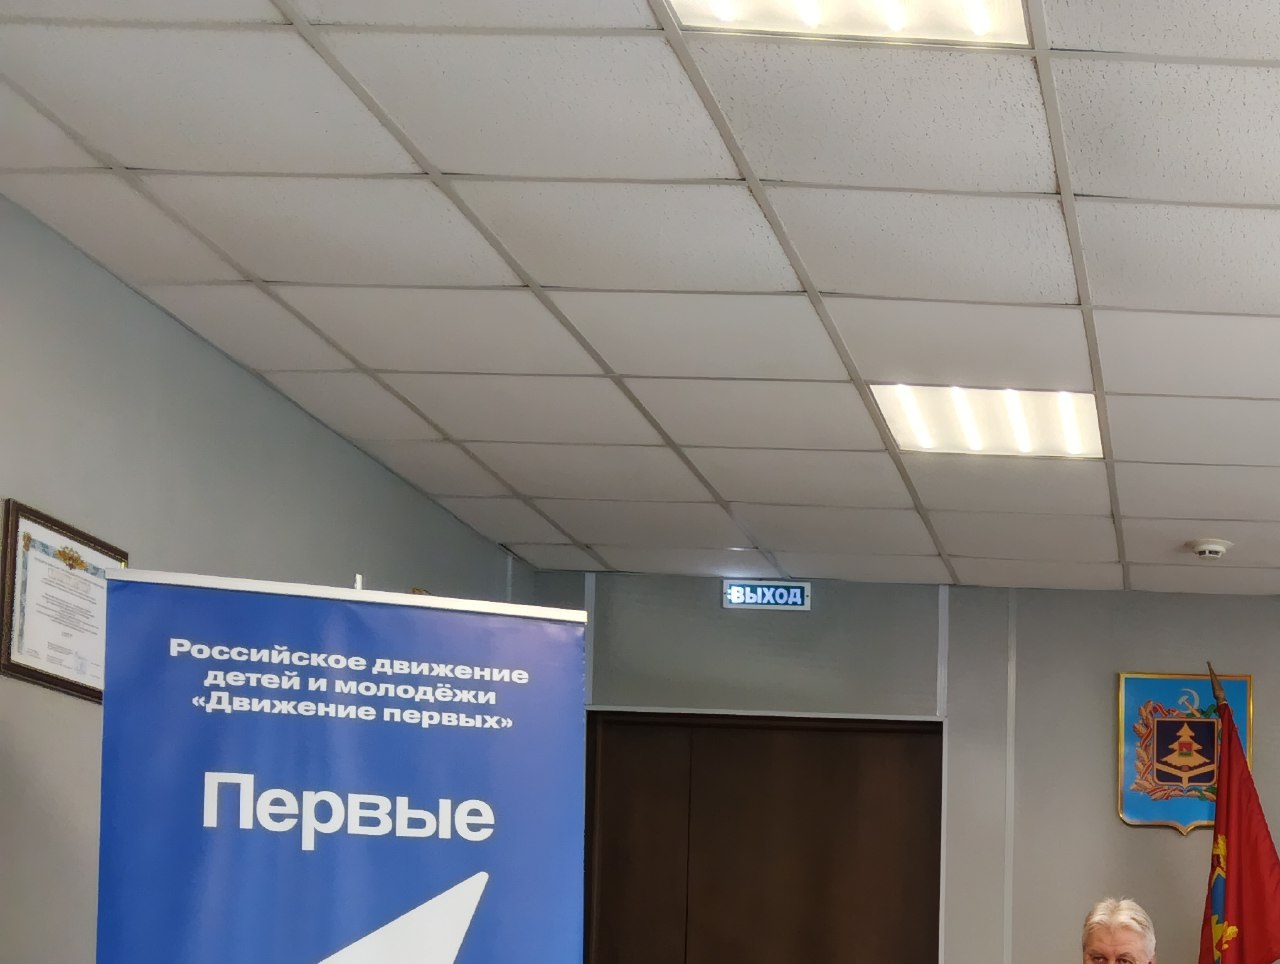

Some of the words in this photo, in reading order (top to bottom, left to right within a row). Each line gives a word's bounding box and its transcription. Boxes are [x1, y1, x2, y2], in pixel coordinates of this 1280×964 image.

[730, 585, 803, 605] ВЫХОД
[168, 637, 367, 672] Российское
[371, 657, 531, 685] движение
[203, 669, 301, 690] детей
[307, 677, 328, 692] и
[334, 679, 497, 706] молодёжи
[190, 690, 377, 722] «Движение
[383, 706, 514, 730] первых»
[202, 770, 496, 852] Первые
